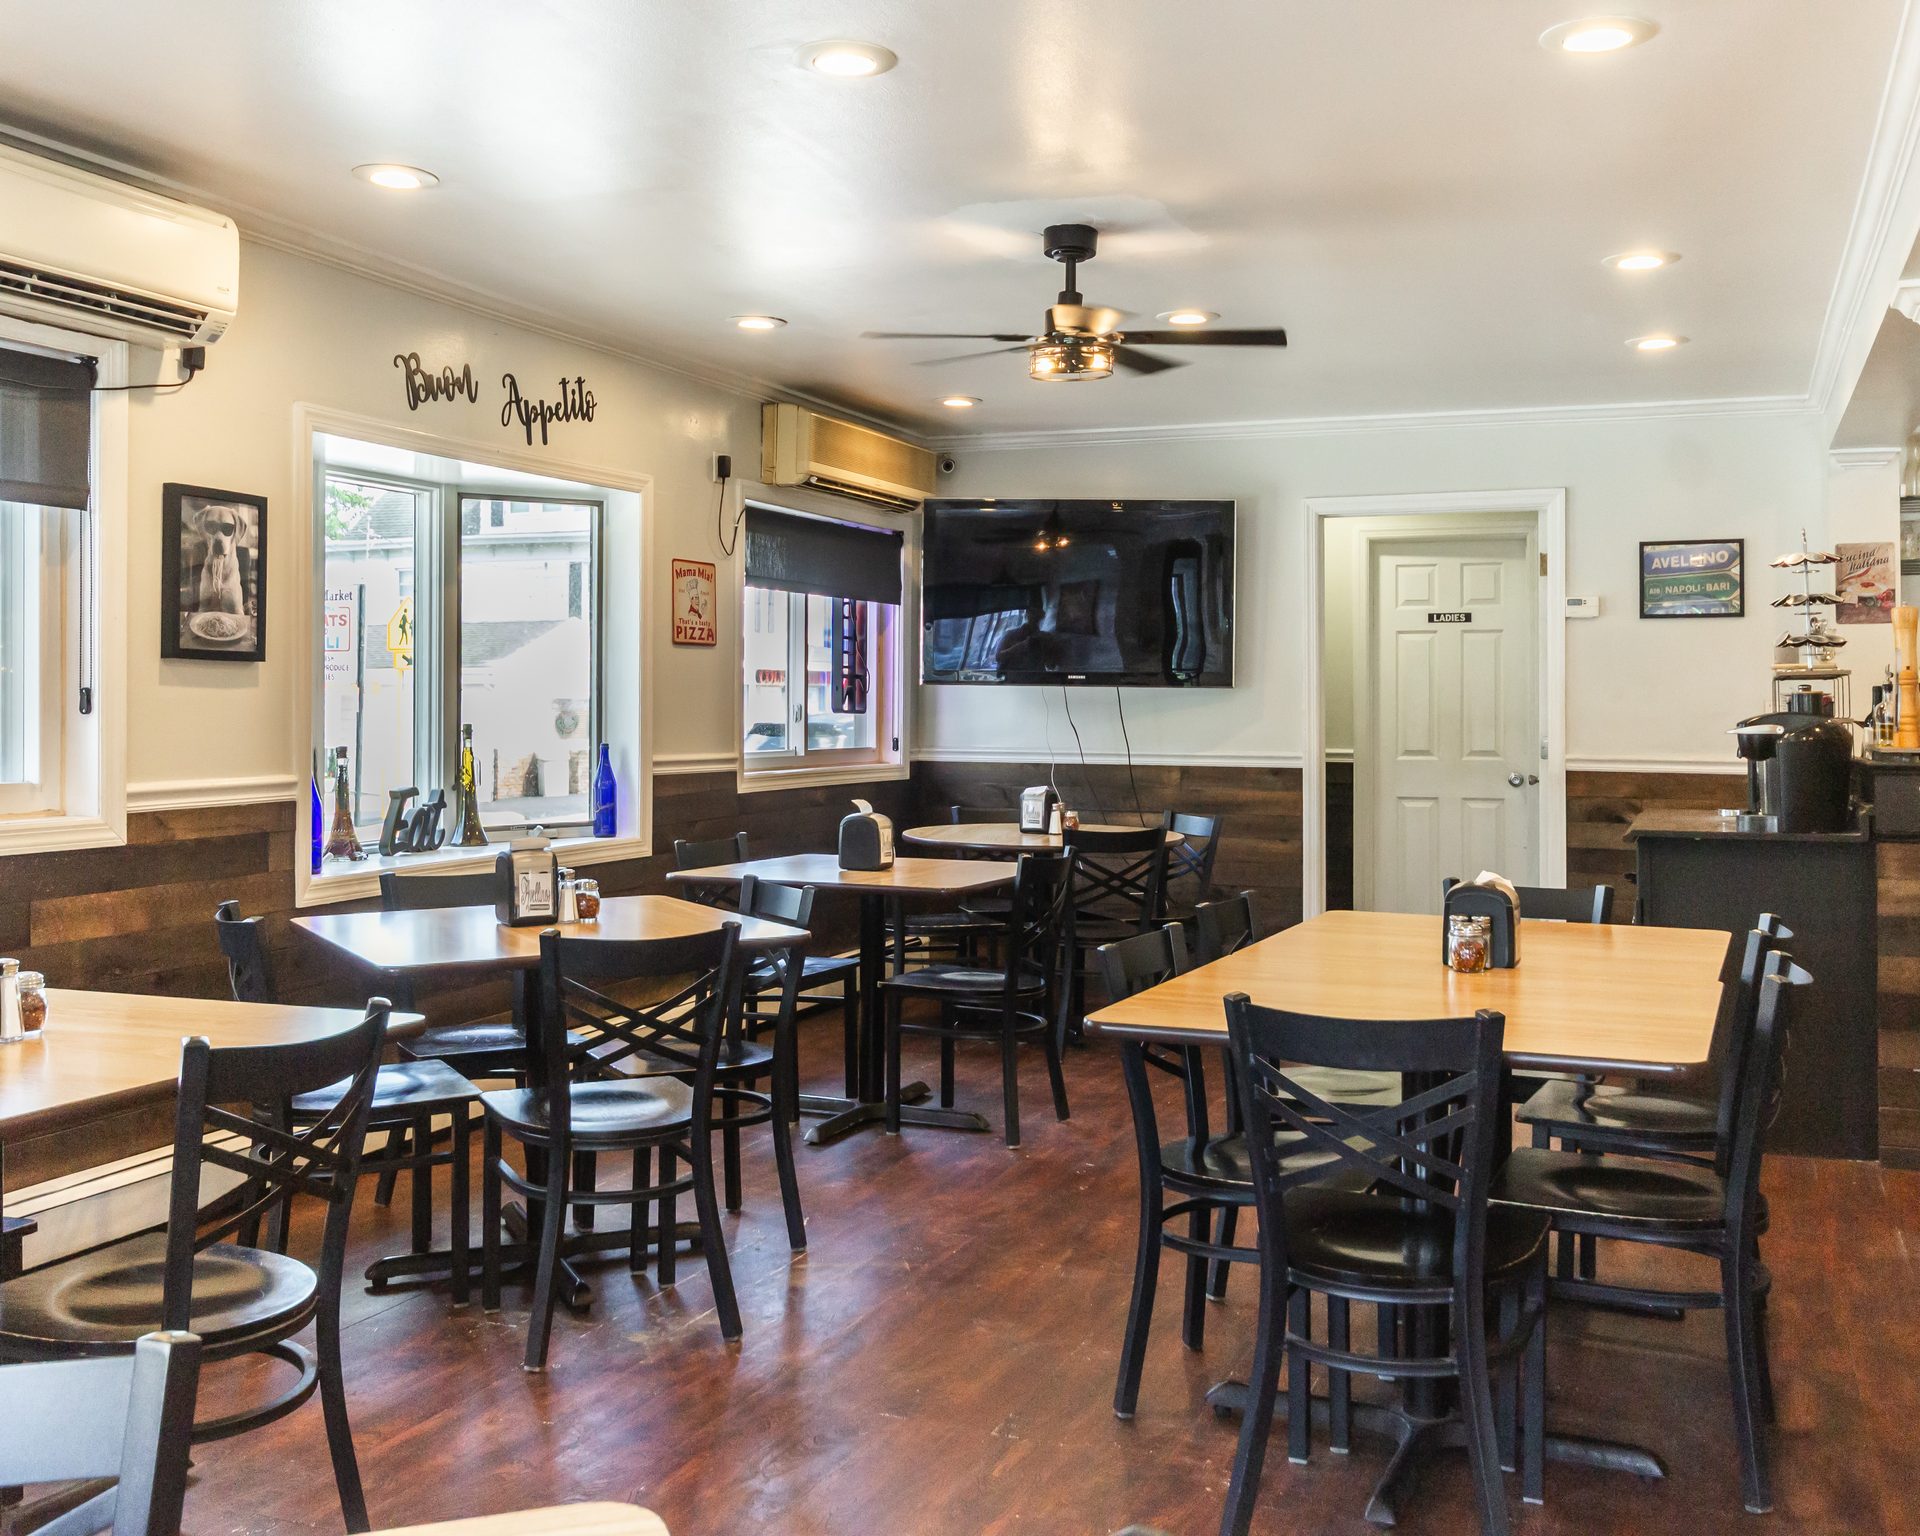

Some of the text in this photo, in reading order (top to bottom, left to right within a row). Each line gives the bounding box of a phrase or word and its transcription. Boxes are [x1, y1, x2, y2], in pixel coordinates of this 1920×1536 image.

[393, 351, 598, 446] Buon Appetito
[1651, 550, 1730, 570] AVELNO
[675, 568, 697, 579] Mama
[1433, 613, 1466, 622] LADIES
[676, 625, 715, 642] PIZZA
[379, 786, 448, 857] Eat
